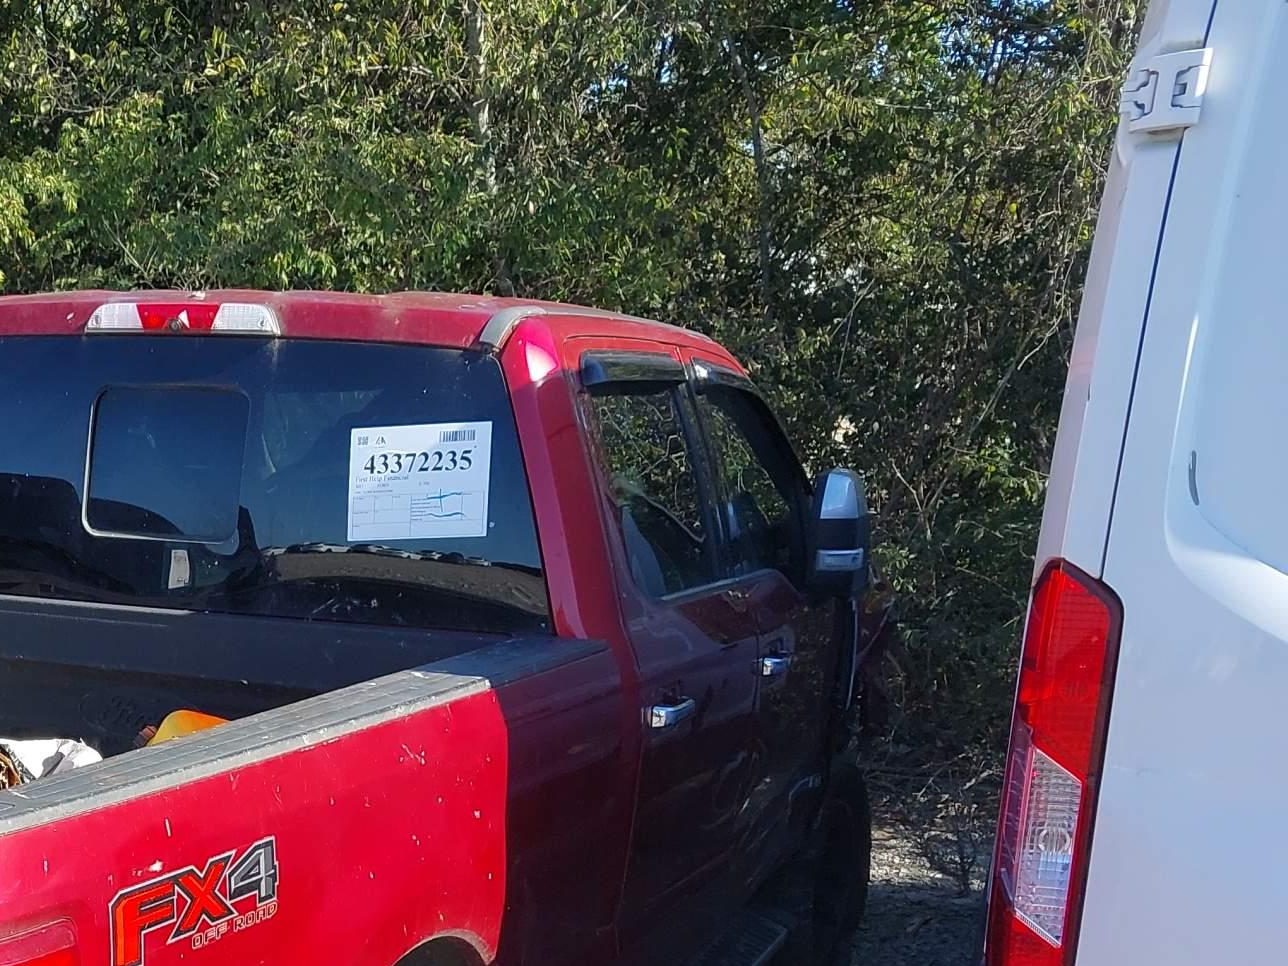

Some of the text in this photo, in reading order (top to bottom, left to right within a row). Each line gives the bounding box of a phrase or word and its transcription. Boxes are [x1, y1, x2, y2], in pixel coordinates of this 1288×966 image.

[364, 449, 473, 475] 43372235
[191, 901, 278, 950] OFF ROAD
